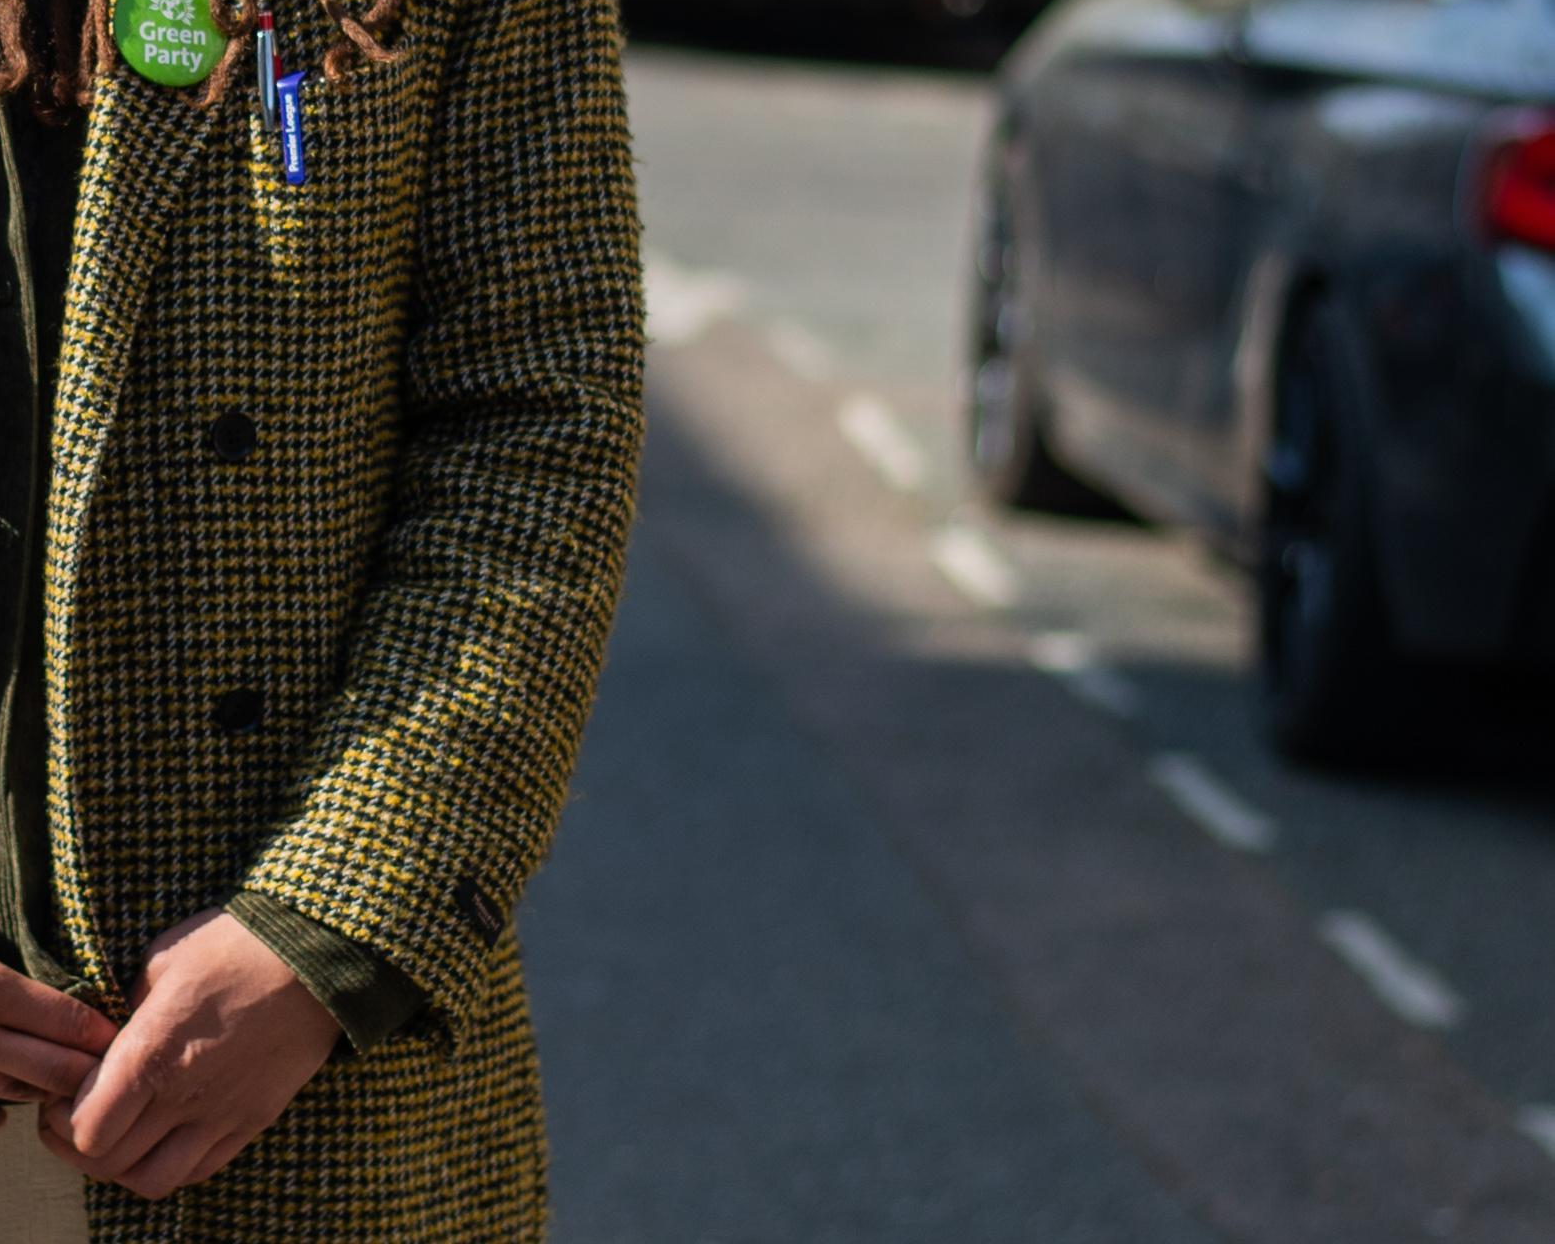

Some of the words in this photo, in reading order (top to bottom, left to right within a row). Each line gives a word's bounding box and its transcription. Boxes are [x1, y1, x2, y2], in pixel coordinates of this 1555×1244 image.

[140, 20, 206, 45] Green
[144, 43, 203, 74] Party
[285, 94, 297, 133] League
[288, 134, 300, 172] Premier
